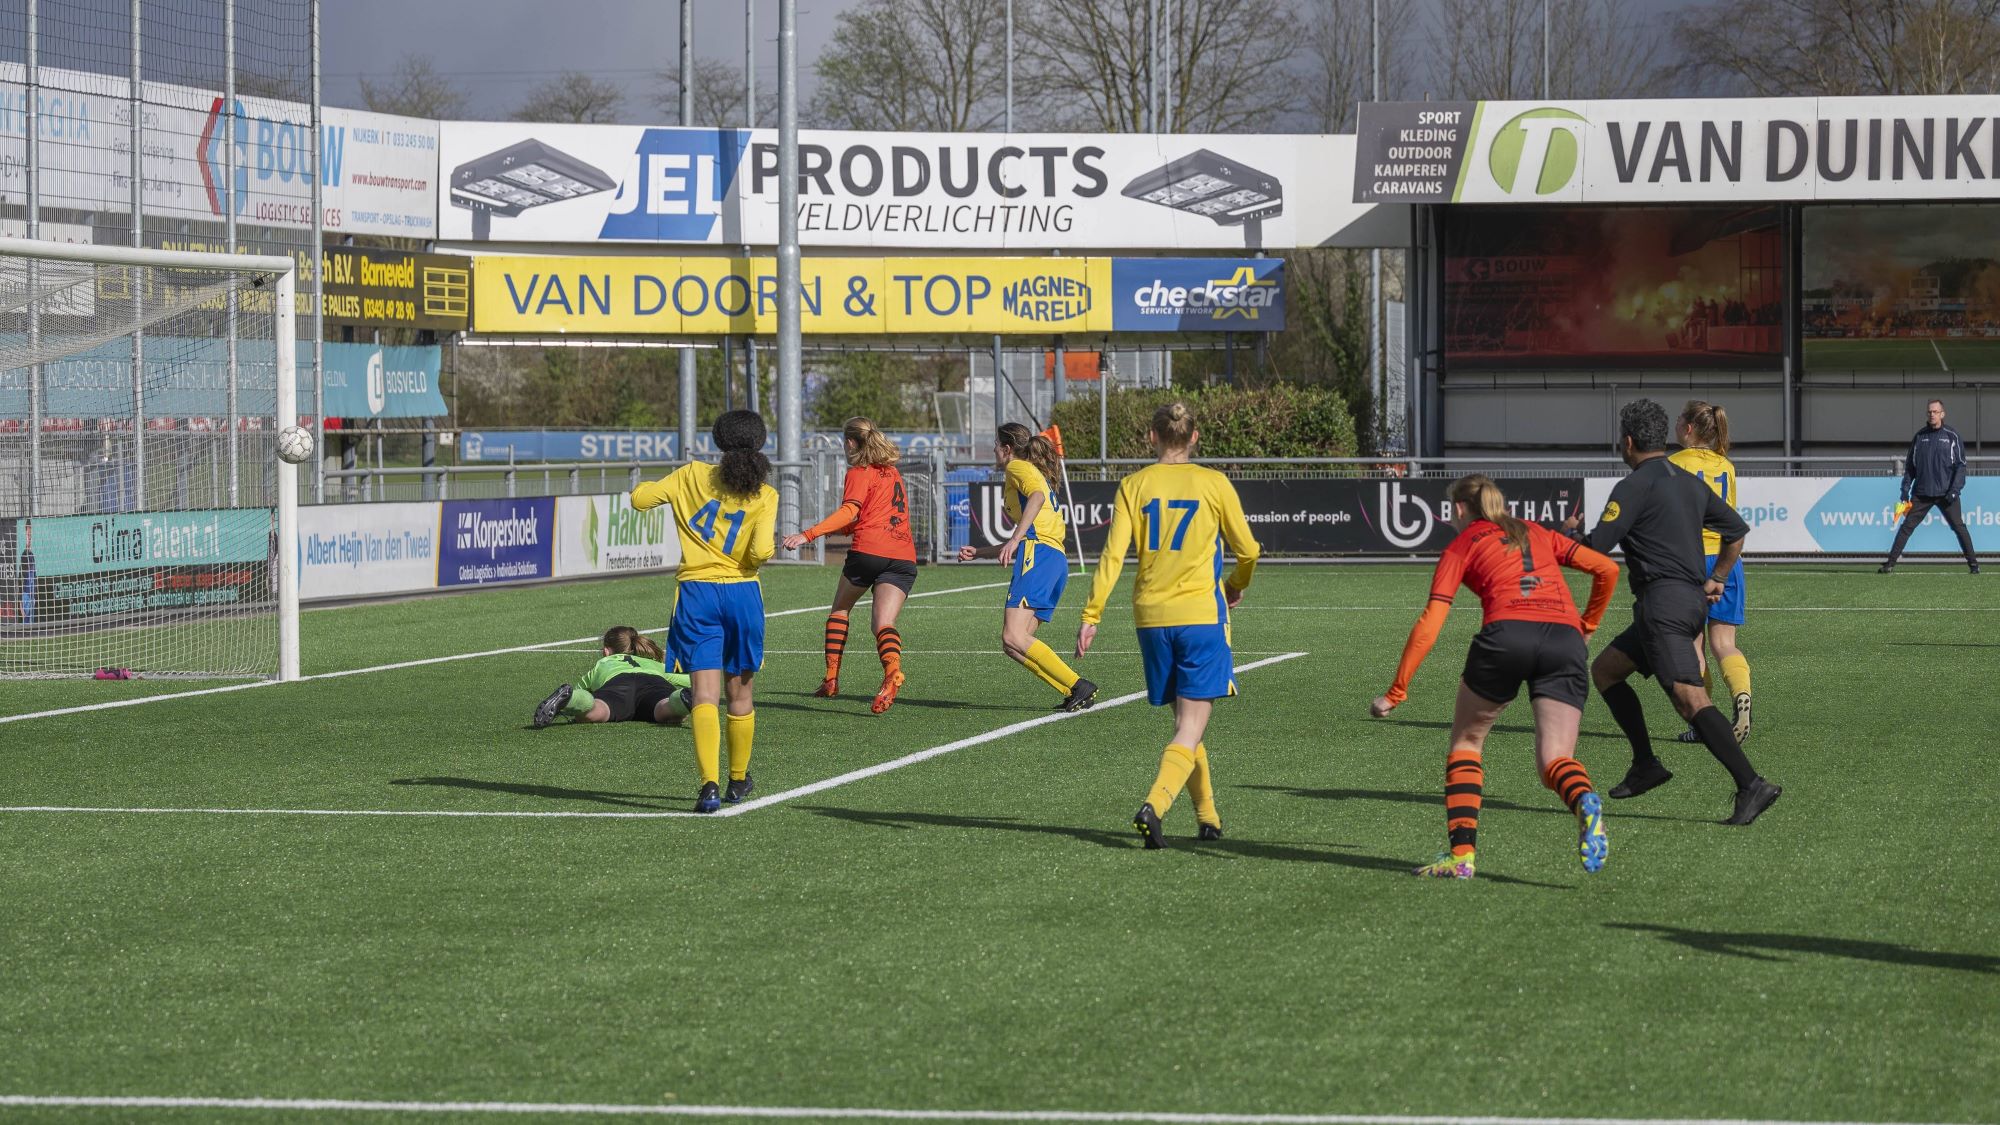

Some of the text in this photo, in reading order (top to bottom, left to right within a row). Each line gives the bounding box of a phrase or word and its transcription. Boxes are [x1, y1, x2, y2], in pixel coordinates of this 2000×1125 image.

[1418, 112, 1461, 125] SPORT
[1400, 129, 1457, 142] KLEDING
[1388, 146, 1452, 160] OUTDOOR
[1606, 120, 1743, 183] VAN
[352, 171, 427, 192] www.bouwtransport.com
[751, 142, 1108, 198] PRODUCTS
[1374, 164, 1447, 177] KAMPEREN
[1373, 181, 1443, 195] CARAVANS
[300, 205, 341, 226] SEICES
[352, 211, 379, 224] TRANSPORT
[334, 254, 354, 285] B.V.
[361, 256, 415, 288] Barneveld
[504, 274, 611, 316] VAN
[844, 275, 876, 316] &
[893, 275, 991, 316] TOP
[1134, 279, 1280, 307] checkstar
[329, 295, 361, 319] PALLETS
[363, 298, 385, 321] (0342)
[386, 300, 394, 319] 49
[396, 301, 405, 321] 28
[406, 302, 415, 321] 90
[1140, 307, 1214, 315] SERVICE NETWORK
[385, 371, 427, 393] BOSVELD
[581, 434, 673, 458] STERK
[891, 481, 906, 513] 4
[607, 494, 665, 546] Hakron
[688, 499, 746, 556] 41
[1141, 498, 1199, 552] 17
[1292, 510, 1306, 522] of
[1309, 510, 1351, 525] people
[474, 506, 538, 559] Korpershoek
[307, 528, 431, 568] Albert Heijn Van den Tweel
[606, 552, 636, 570] Trendsetters
[643, 551, 648, 568] de
[650, 550, 663, 567] bouw
[459, 561, 537, 584] Global Logistics Individual Solutions
